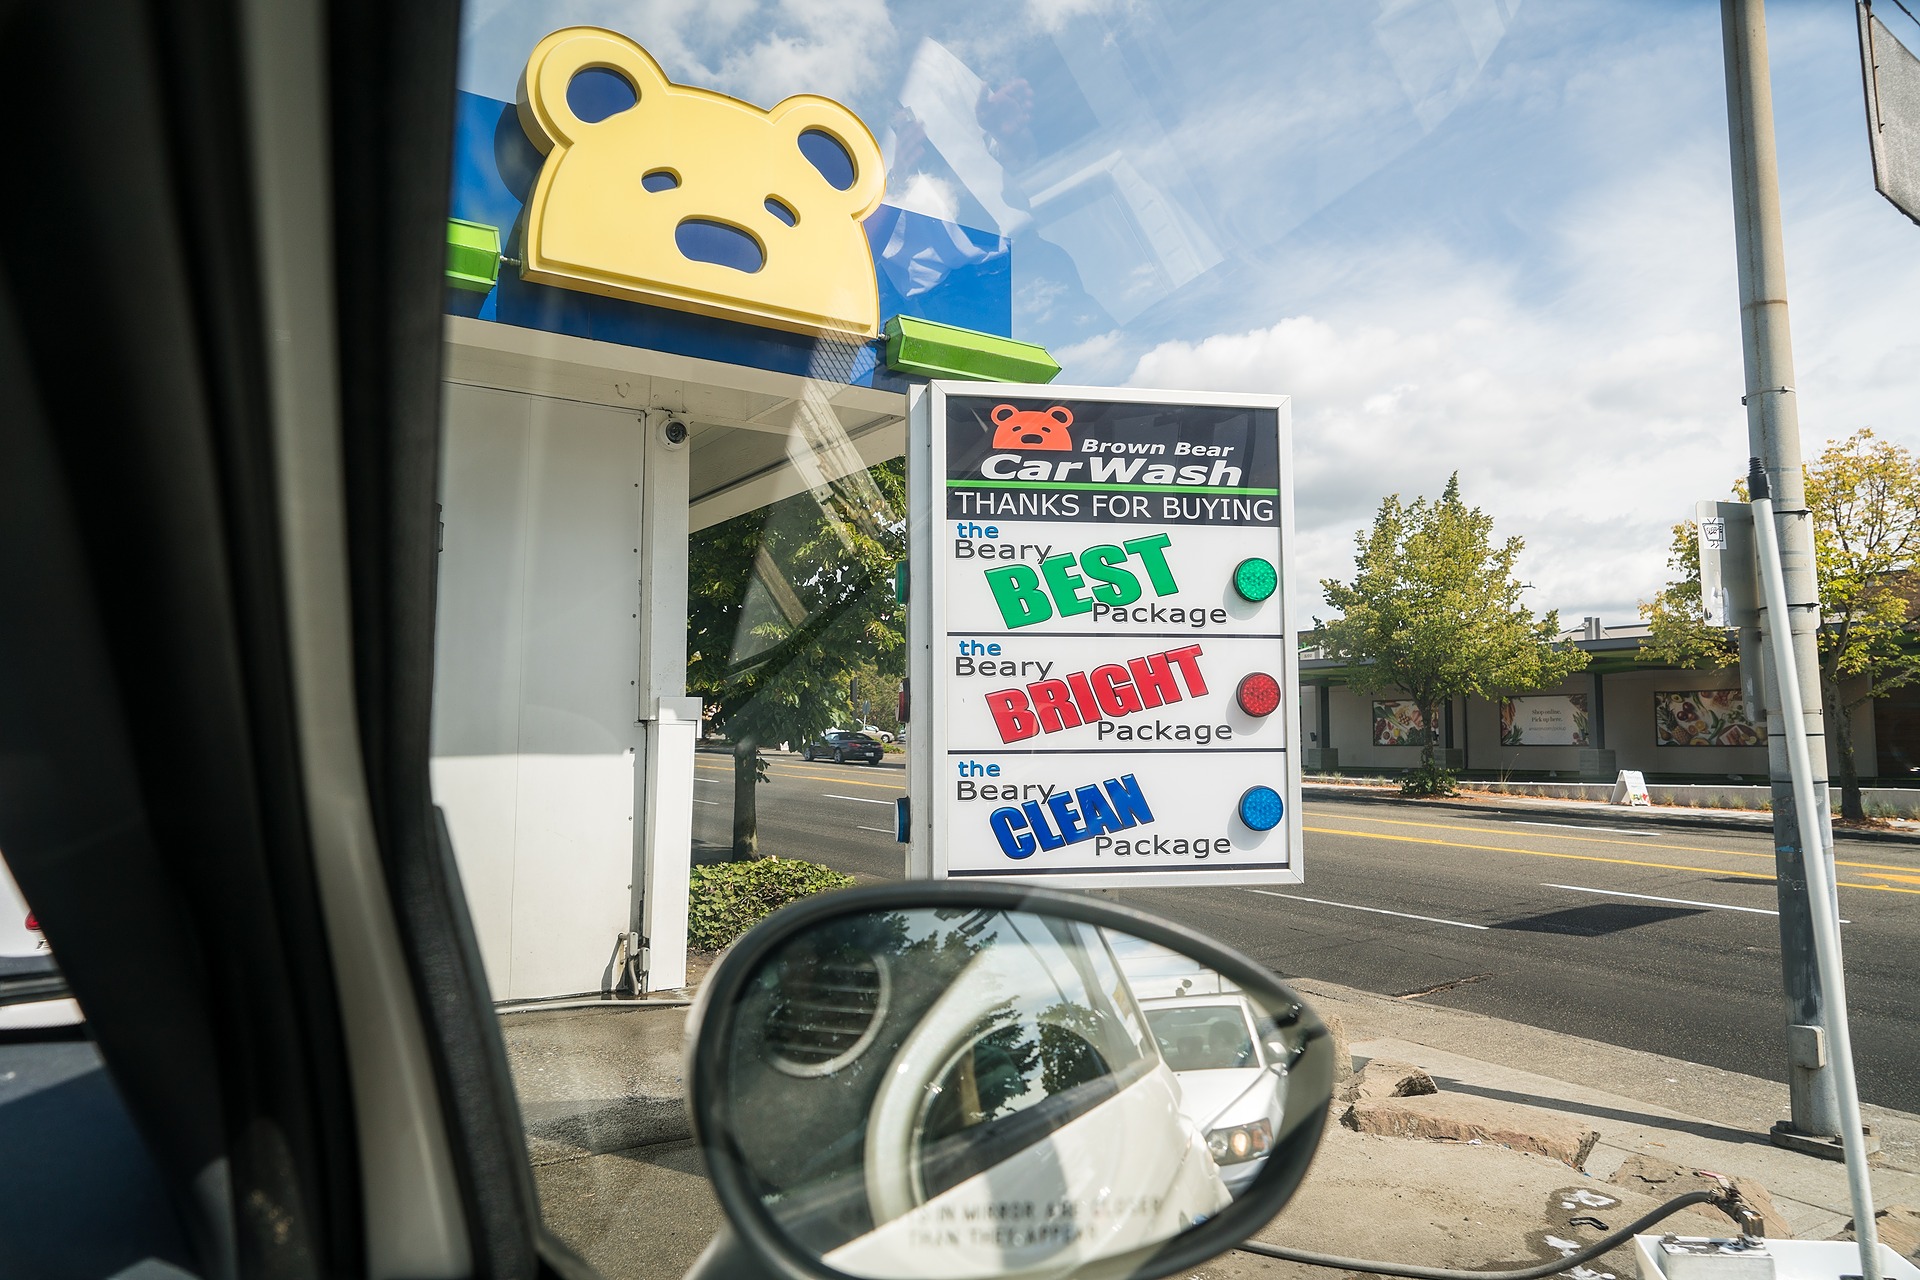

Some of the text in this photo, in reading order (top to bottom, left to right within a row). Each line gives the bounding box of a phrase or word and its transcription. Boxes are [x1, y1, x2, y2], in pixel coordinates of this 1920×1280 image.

[1080, 438, 1235, 457] Brown Bear
[954, 491, 1274, 522] THANKS FOR BUYING
[956, 521, 999, 539] the
[955, 538, 1053, 566] Beary
[983, 532, 1180, 630] BEST
[1093, 602, 1227, 628] Package
[959, 639, 1001, 656] the
[955, 656, 1054, 682] Beary
[984, 643, 1210, 745] BRIGHT
[1097, 720, 1232, 745] Package
[958, 760, 1001, 777] the
[957, 780, 1056, 805] Beary
[988, 772, 1156, 860] CLEAN
[1095, 834, 1231, 859] Package
